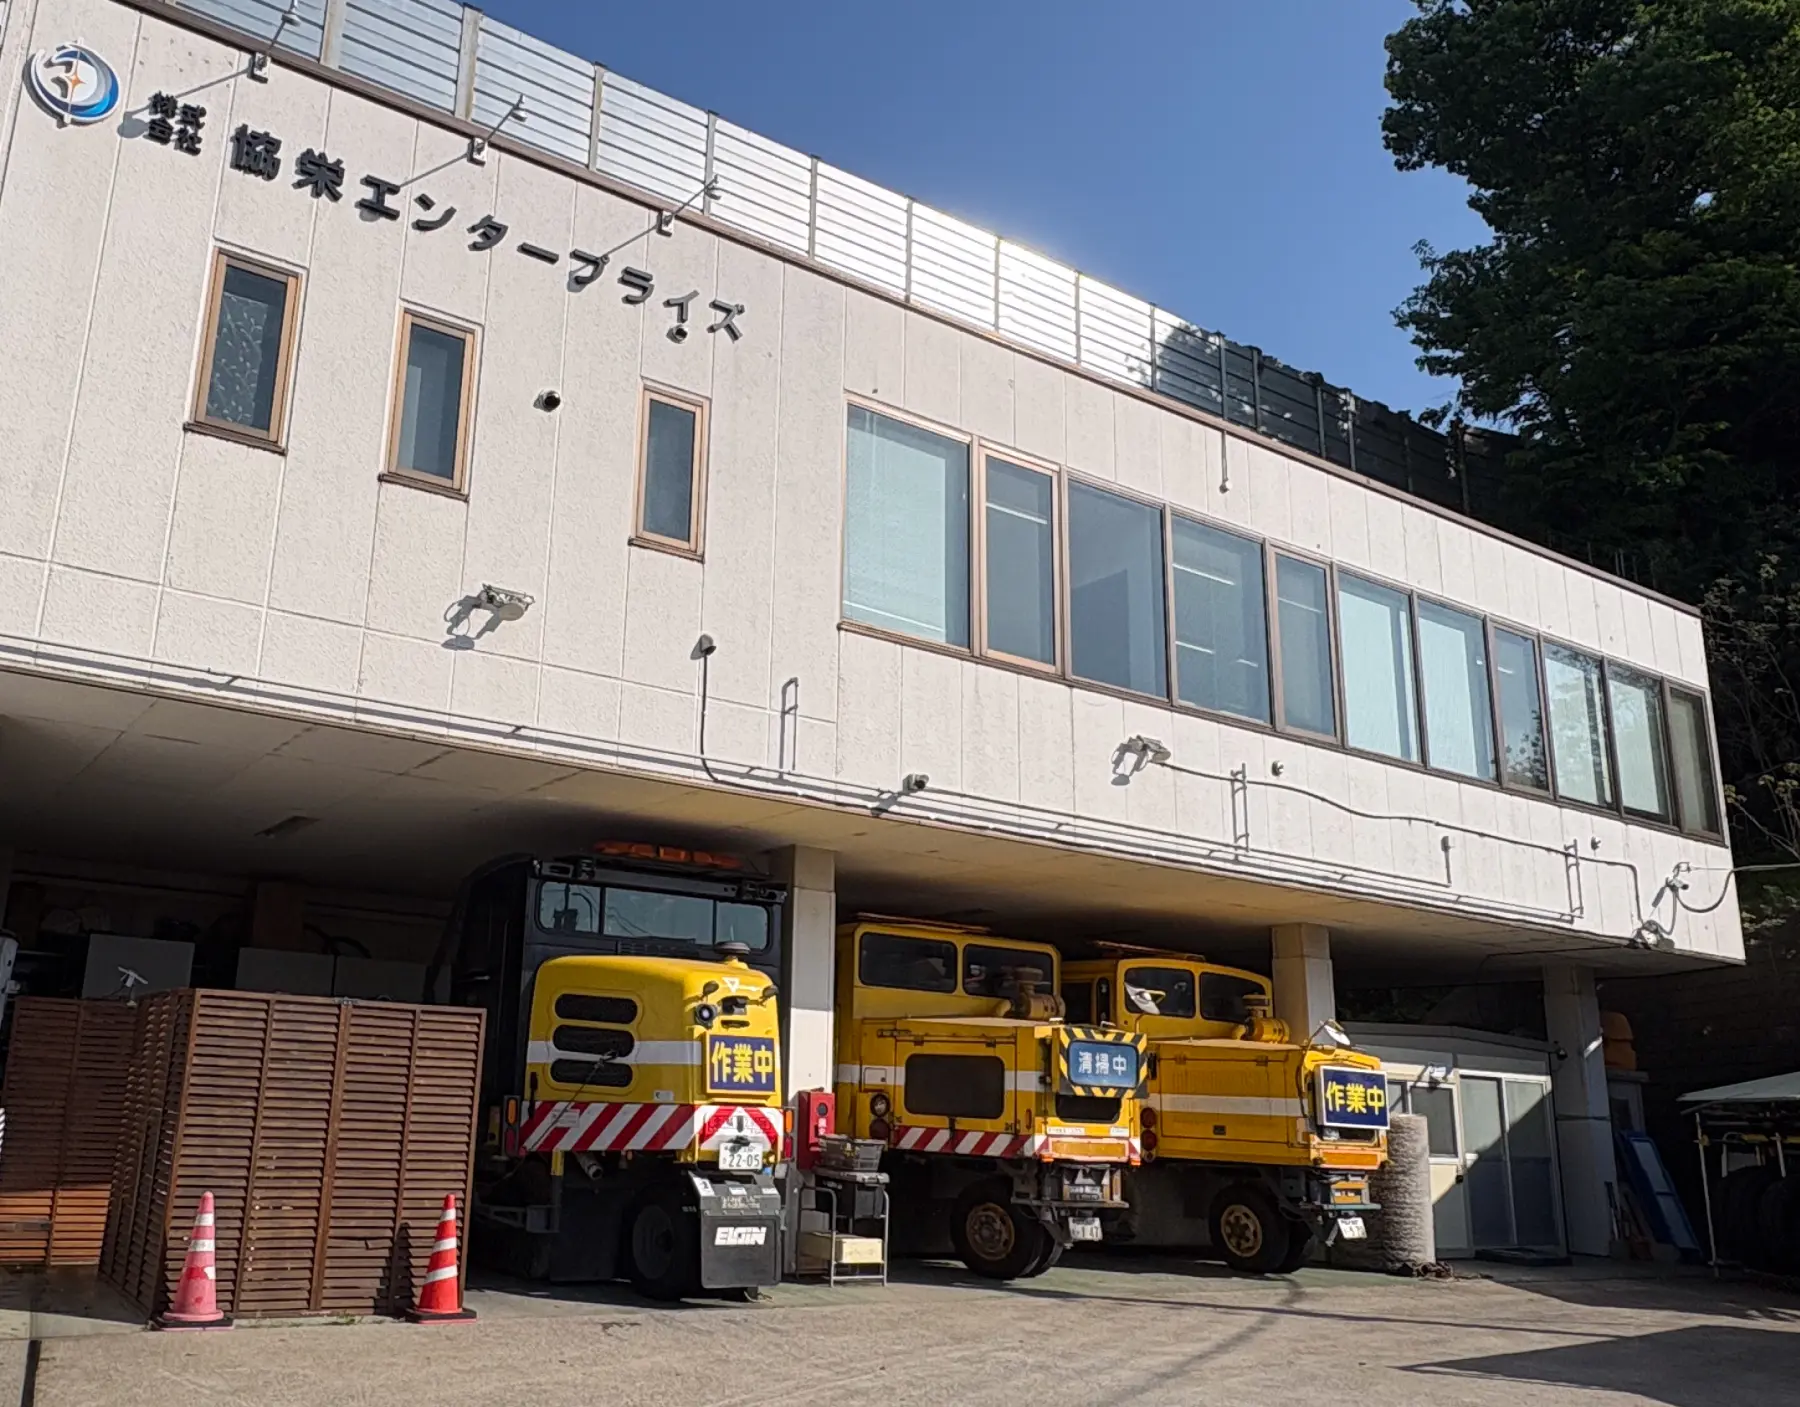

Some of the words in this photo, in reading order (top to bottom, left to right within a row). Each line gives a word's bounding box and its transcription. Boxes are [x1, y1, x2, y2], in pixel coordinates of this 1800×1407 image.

[230, 123, 745, 343] 協栄エンタープライズ
[711, 1040, 773, 1085] 作業中
[1078, 1051, 1127, 1076] 清掃中
[1326, 1080, 1385, 1116] 作業中
[715, 1226, 767, 1246] ELGIN
